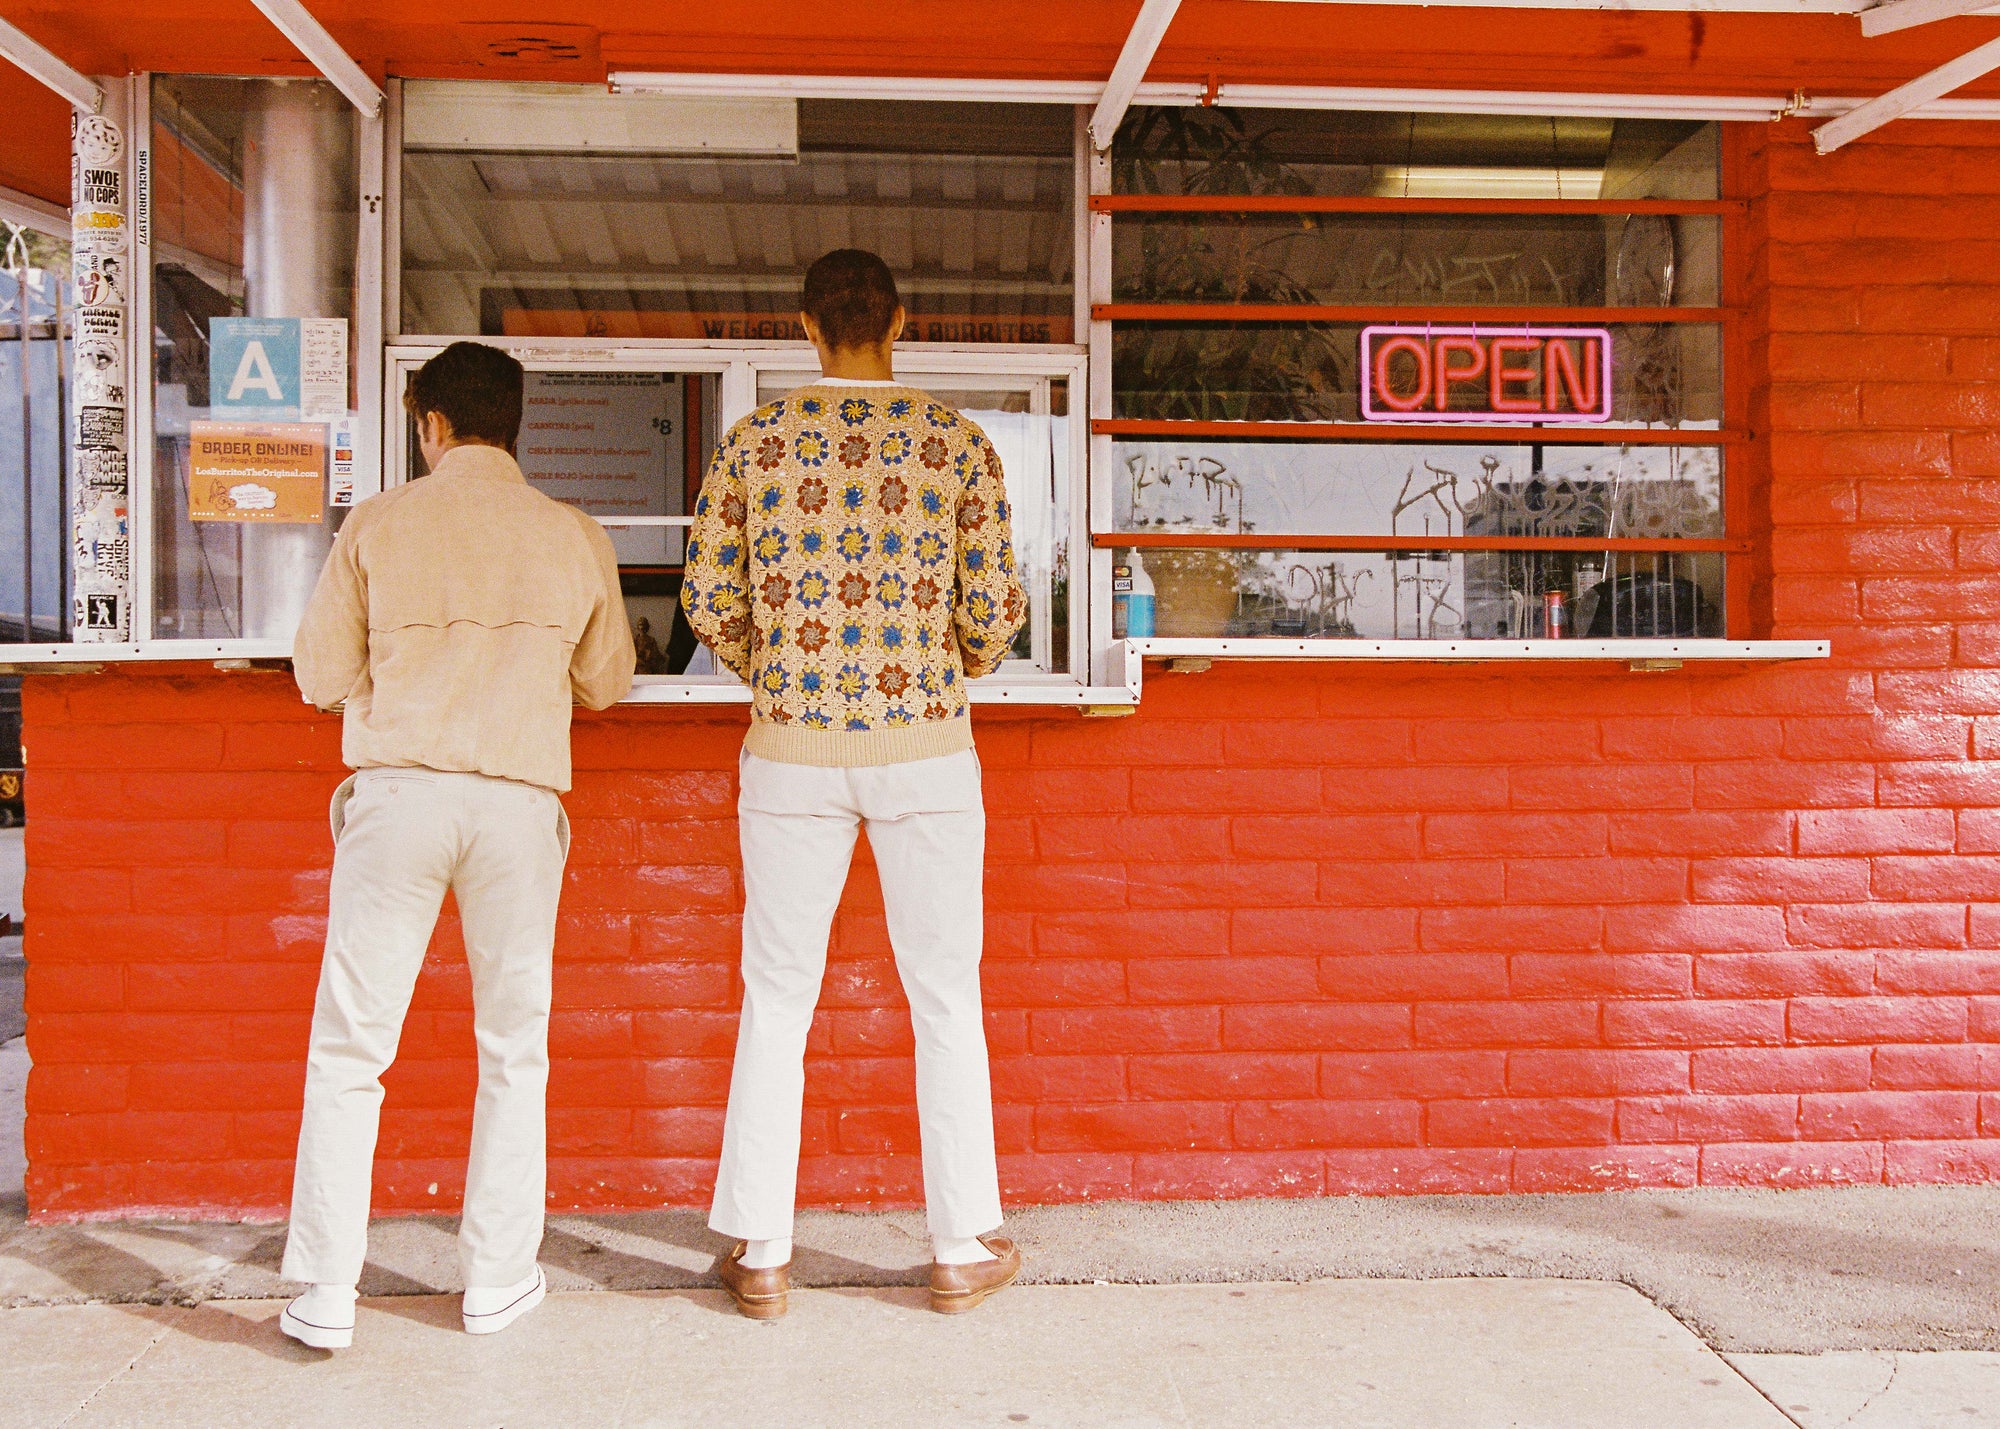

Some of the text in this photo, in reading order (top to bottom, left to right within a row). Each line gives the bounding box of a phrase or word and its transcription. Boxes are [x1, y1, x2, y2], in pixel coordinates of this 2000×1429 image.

[84, 169, 119, 187] SWOE
[96, 188, 119, 204] COPS
[703, 320, 805, 341] WELCOM
[227, 341, 284, 400] A
[1375, 336, 1599, 413] OPEN
[652, 417, 671, 435] $8
[202, 442, 313, 456] ORDER ONLINE!
[195, 467, 319, 478] LosBurritosTheOriginal.com
